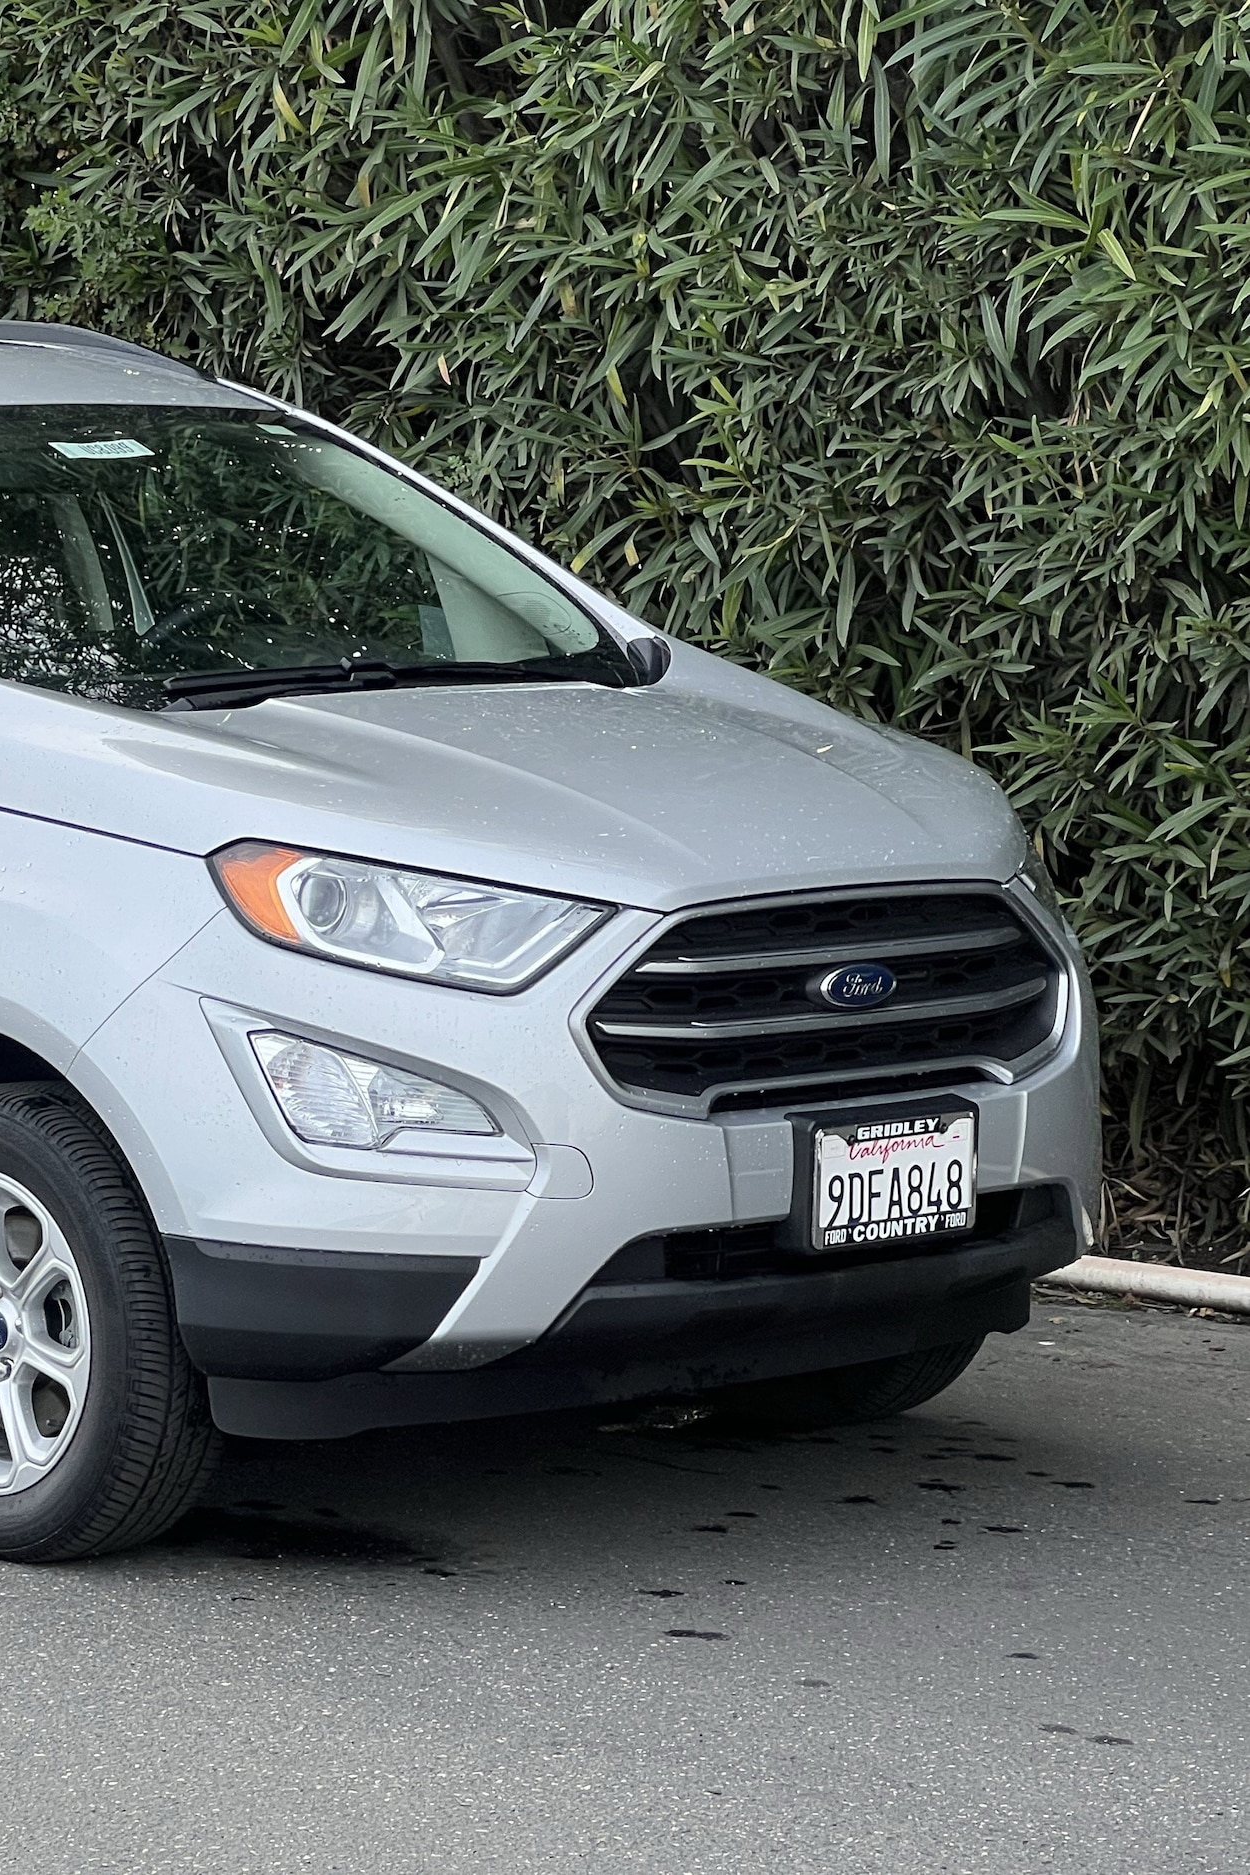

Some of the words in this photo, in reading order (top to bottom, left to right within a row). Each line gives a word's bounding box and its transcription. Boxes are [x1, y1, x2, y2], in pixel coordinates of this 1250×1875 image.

[842, 972, 884, 998] Ford
[856, 1117, 940, 1140] GRIDLEY
[848, 1134, 945, 1164] California
[827, 1159, 963, 1227] 9DFA848
[824, 1227, 847, 1246] FORD
[852, 1214, 939, 1243] COUNTRY
[944, 1211, 967, 1228] FORD
